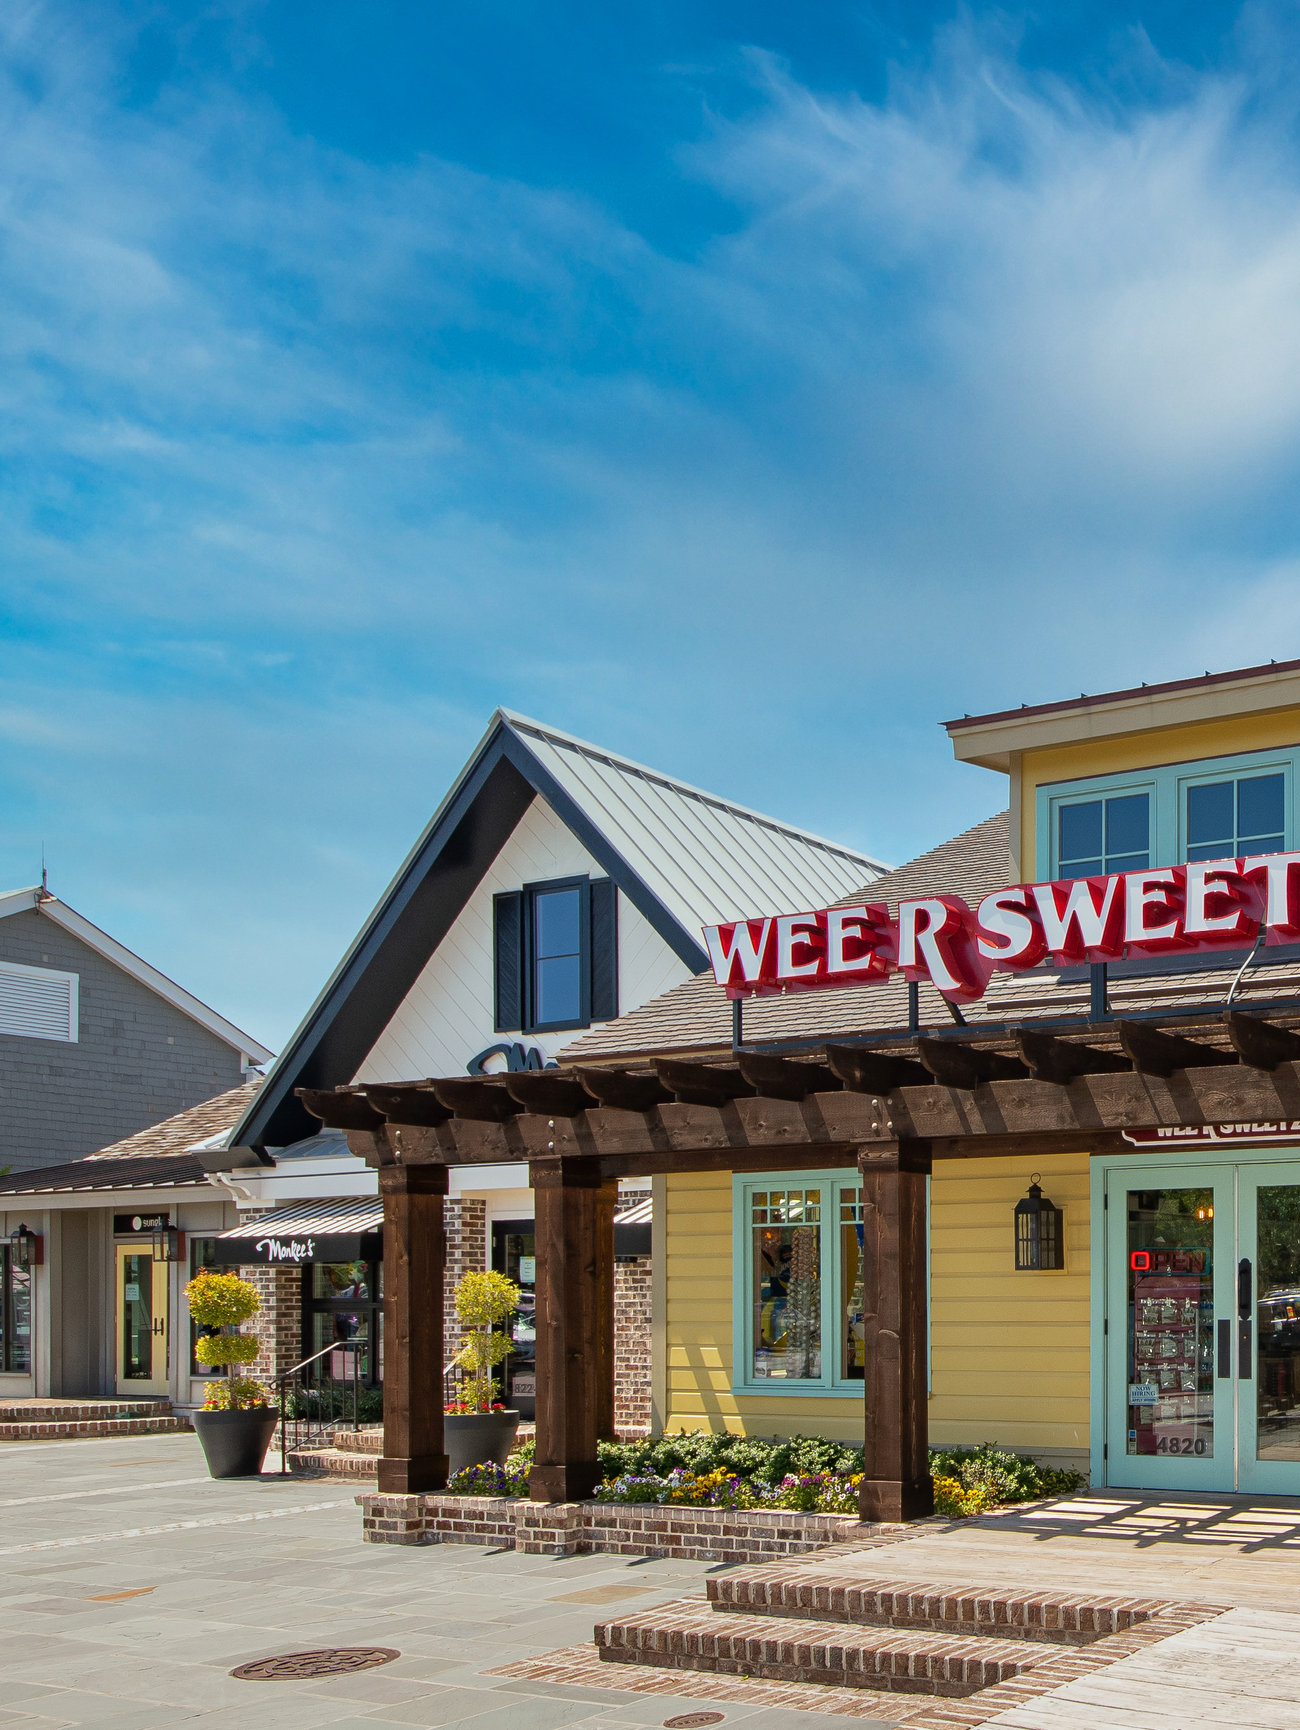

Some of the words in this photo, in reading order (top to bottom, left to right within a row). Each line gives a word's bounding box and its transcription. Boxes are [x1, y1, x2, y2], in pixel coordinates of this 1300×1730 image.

[256, 1239, 313, 1262] Monkee's
[1131, 1251, 1203, 1274] OPEN
[1157, 1436, 1208, 1455] 4820
